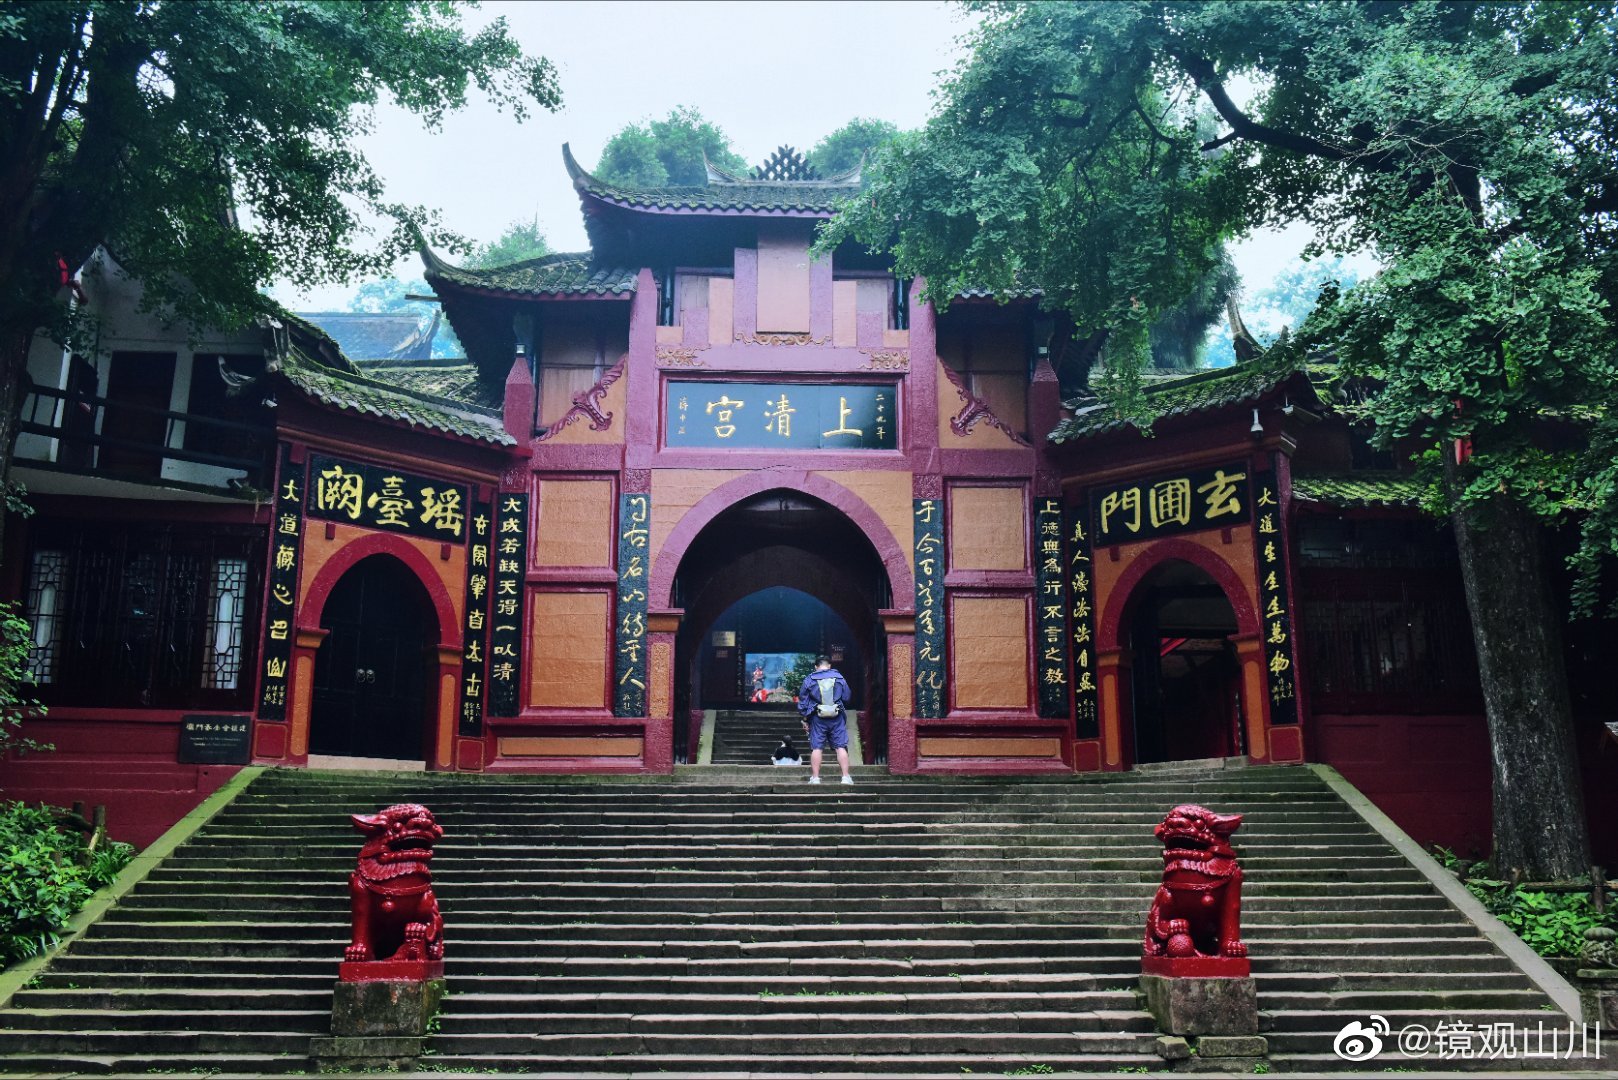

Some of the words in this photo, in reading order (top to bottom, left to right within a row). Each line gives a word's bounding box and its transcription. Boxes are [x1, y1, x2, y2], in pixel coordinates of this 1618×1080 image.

[493, 497, 523, 681] 大成若缺天得一以清
